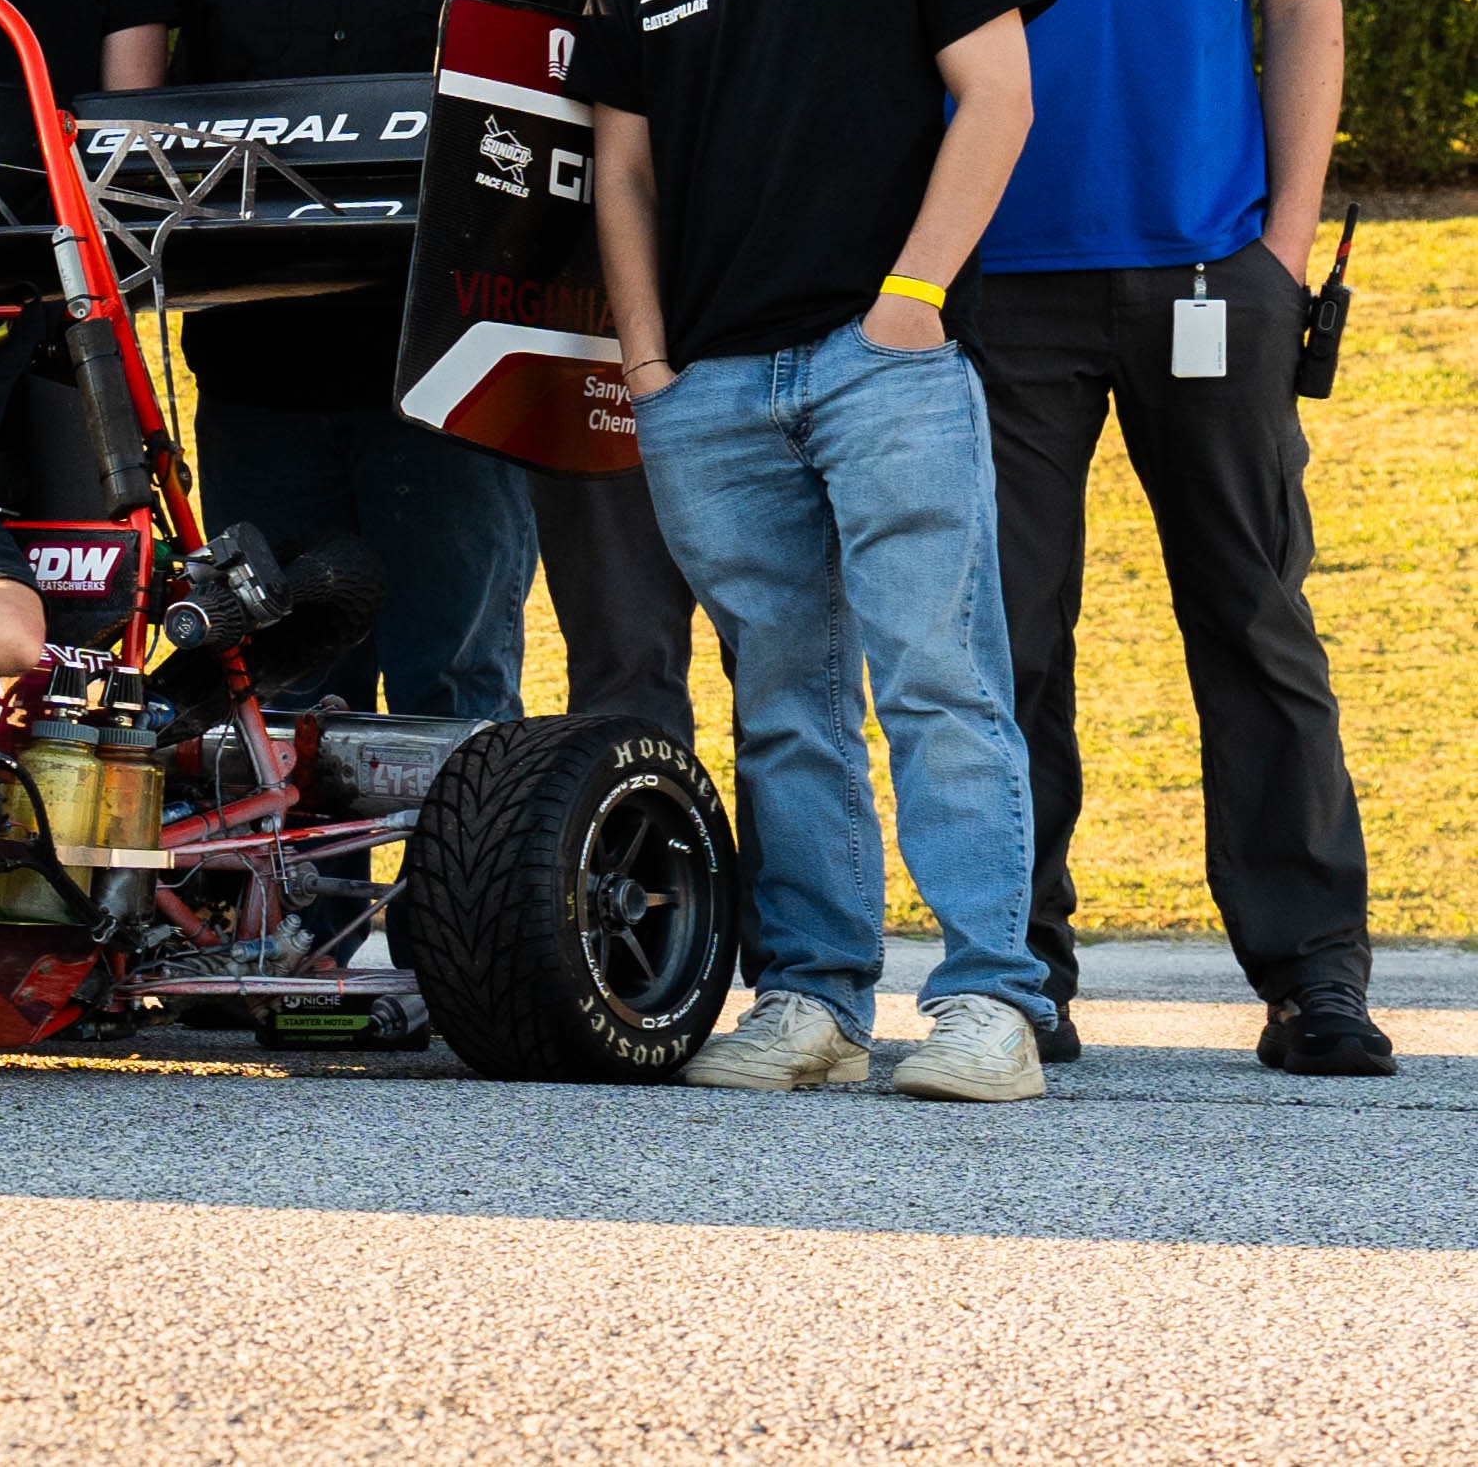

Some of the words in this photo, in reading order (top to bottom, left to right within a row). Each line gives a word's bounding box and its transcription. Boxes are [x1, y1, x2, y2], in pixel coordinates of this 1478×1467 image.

[86, 113, 360, 154] GNERAL
[483, 136, 531, 165] SUNOCO
[475, 172, 503, 191] RACE
[502, 179, 530, 199] FUELS
